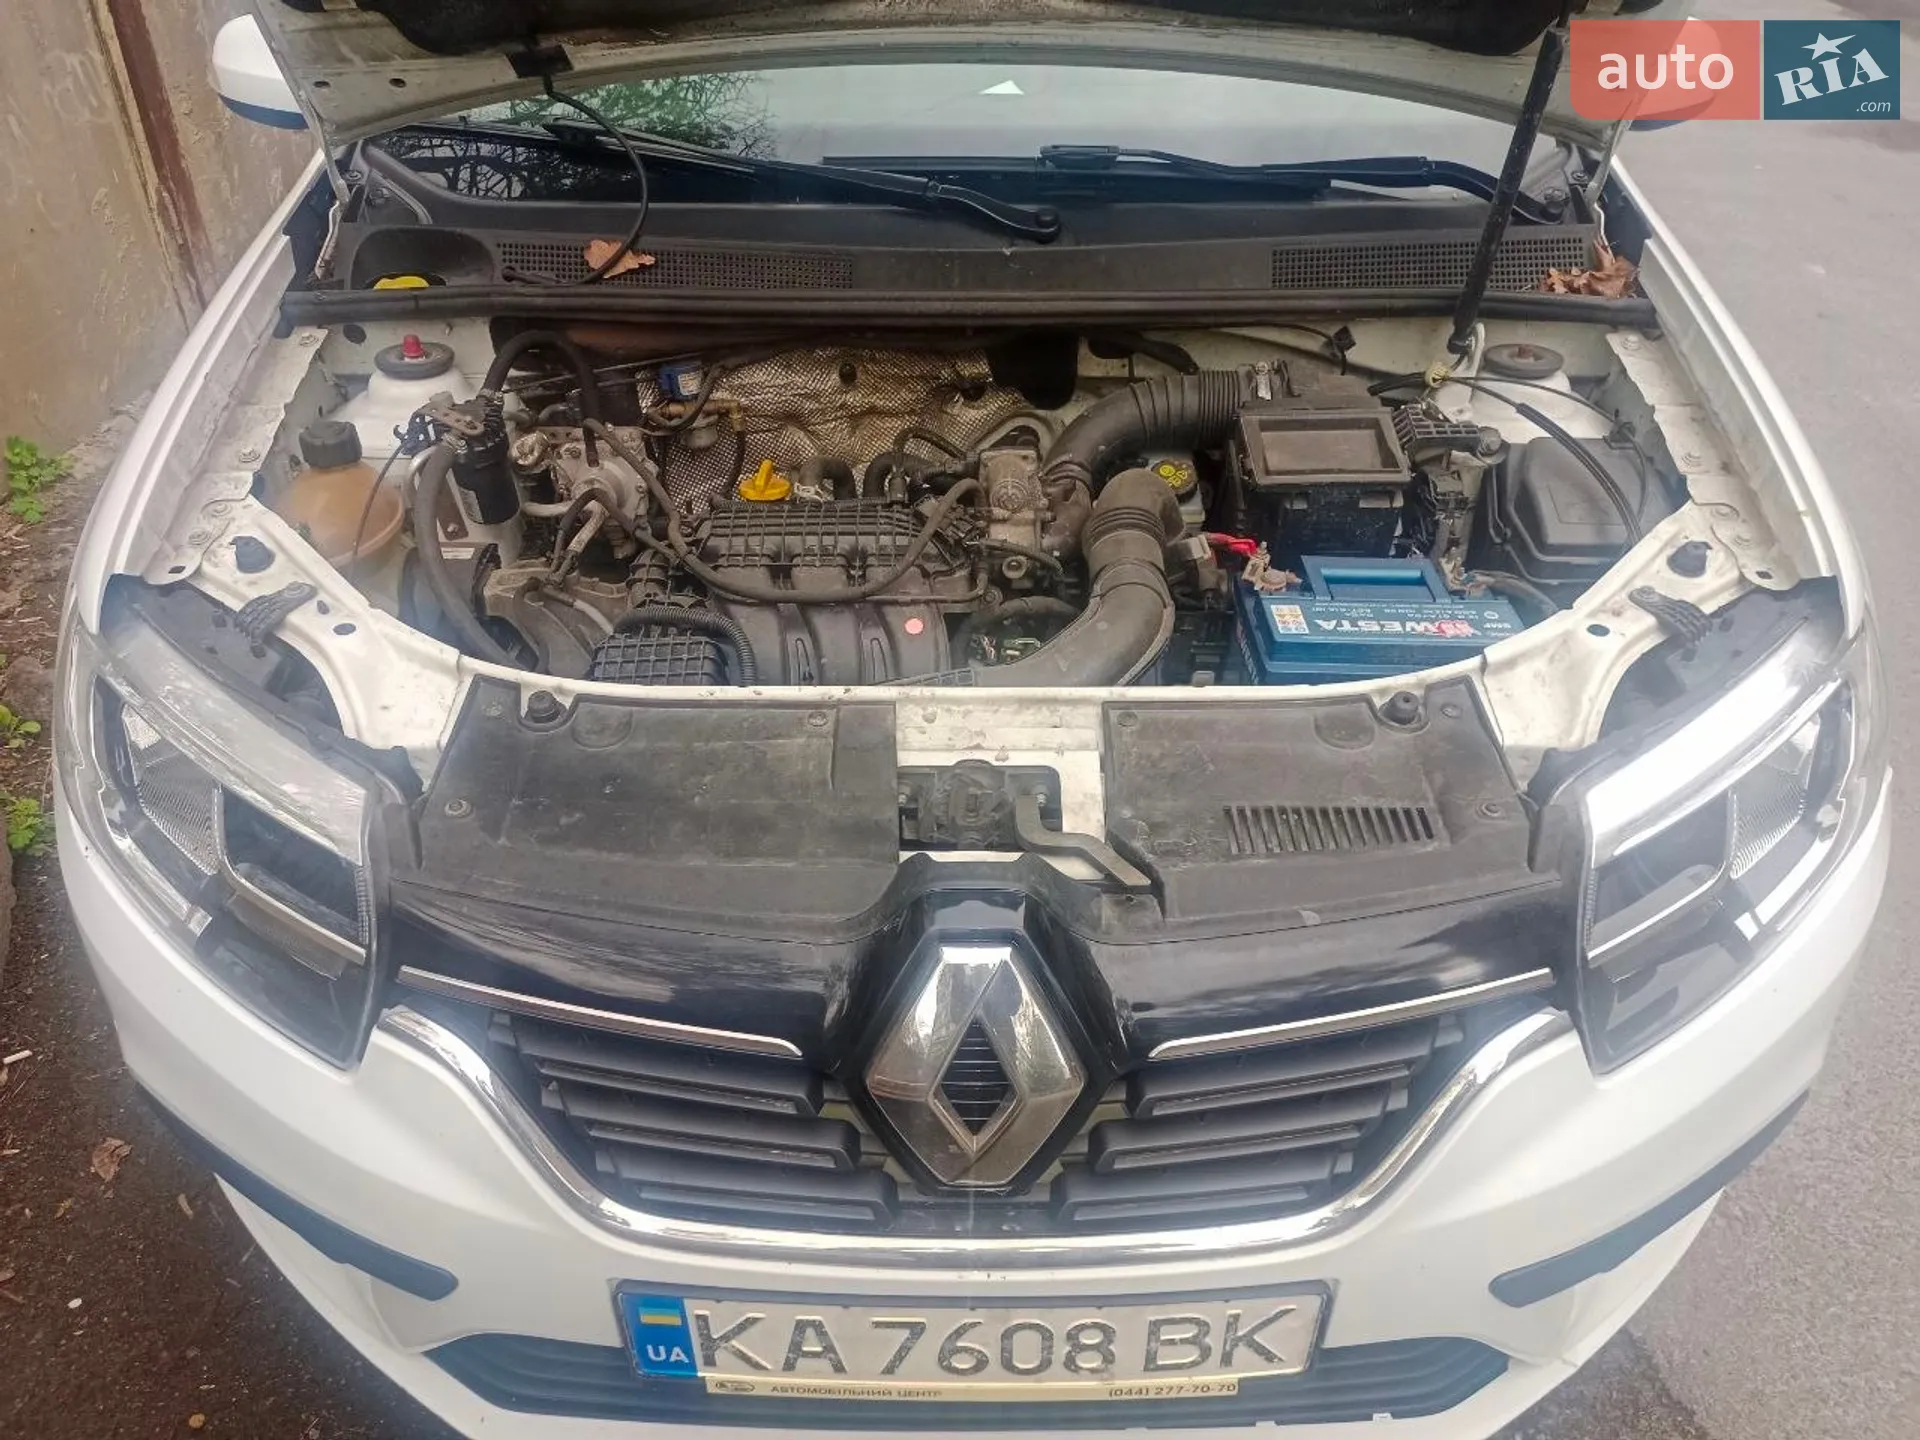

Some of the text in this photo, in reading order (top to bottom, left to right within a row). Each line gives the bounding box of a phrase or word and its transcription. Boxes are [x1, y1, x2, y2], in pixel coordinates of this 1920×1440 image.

[1314, 619, 1438, 635] WESTA
[694, 1305, 1298, 1377] KA 7608 BK
[647, 1345, 690, 1363] UA
[770, 1385, 943, 1399] АВТОМОБІЛЬНИЙ ЦЕНТР
[1108, 1382, 1237, 1398] (044) 277-70-70
